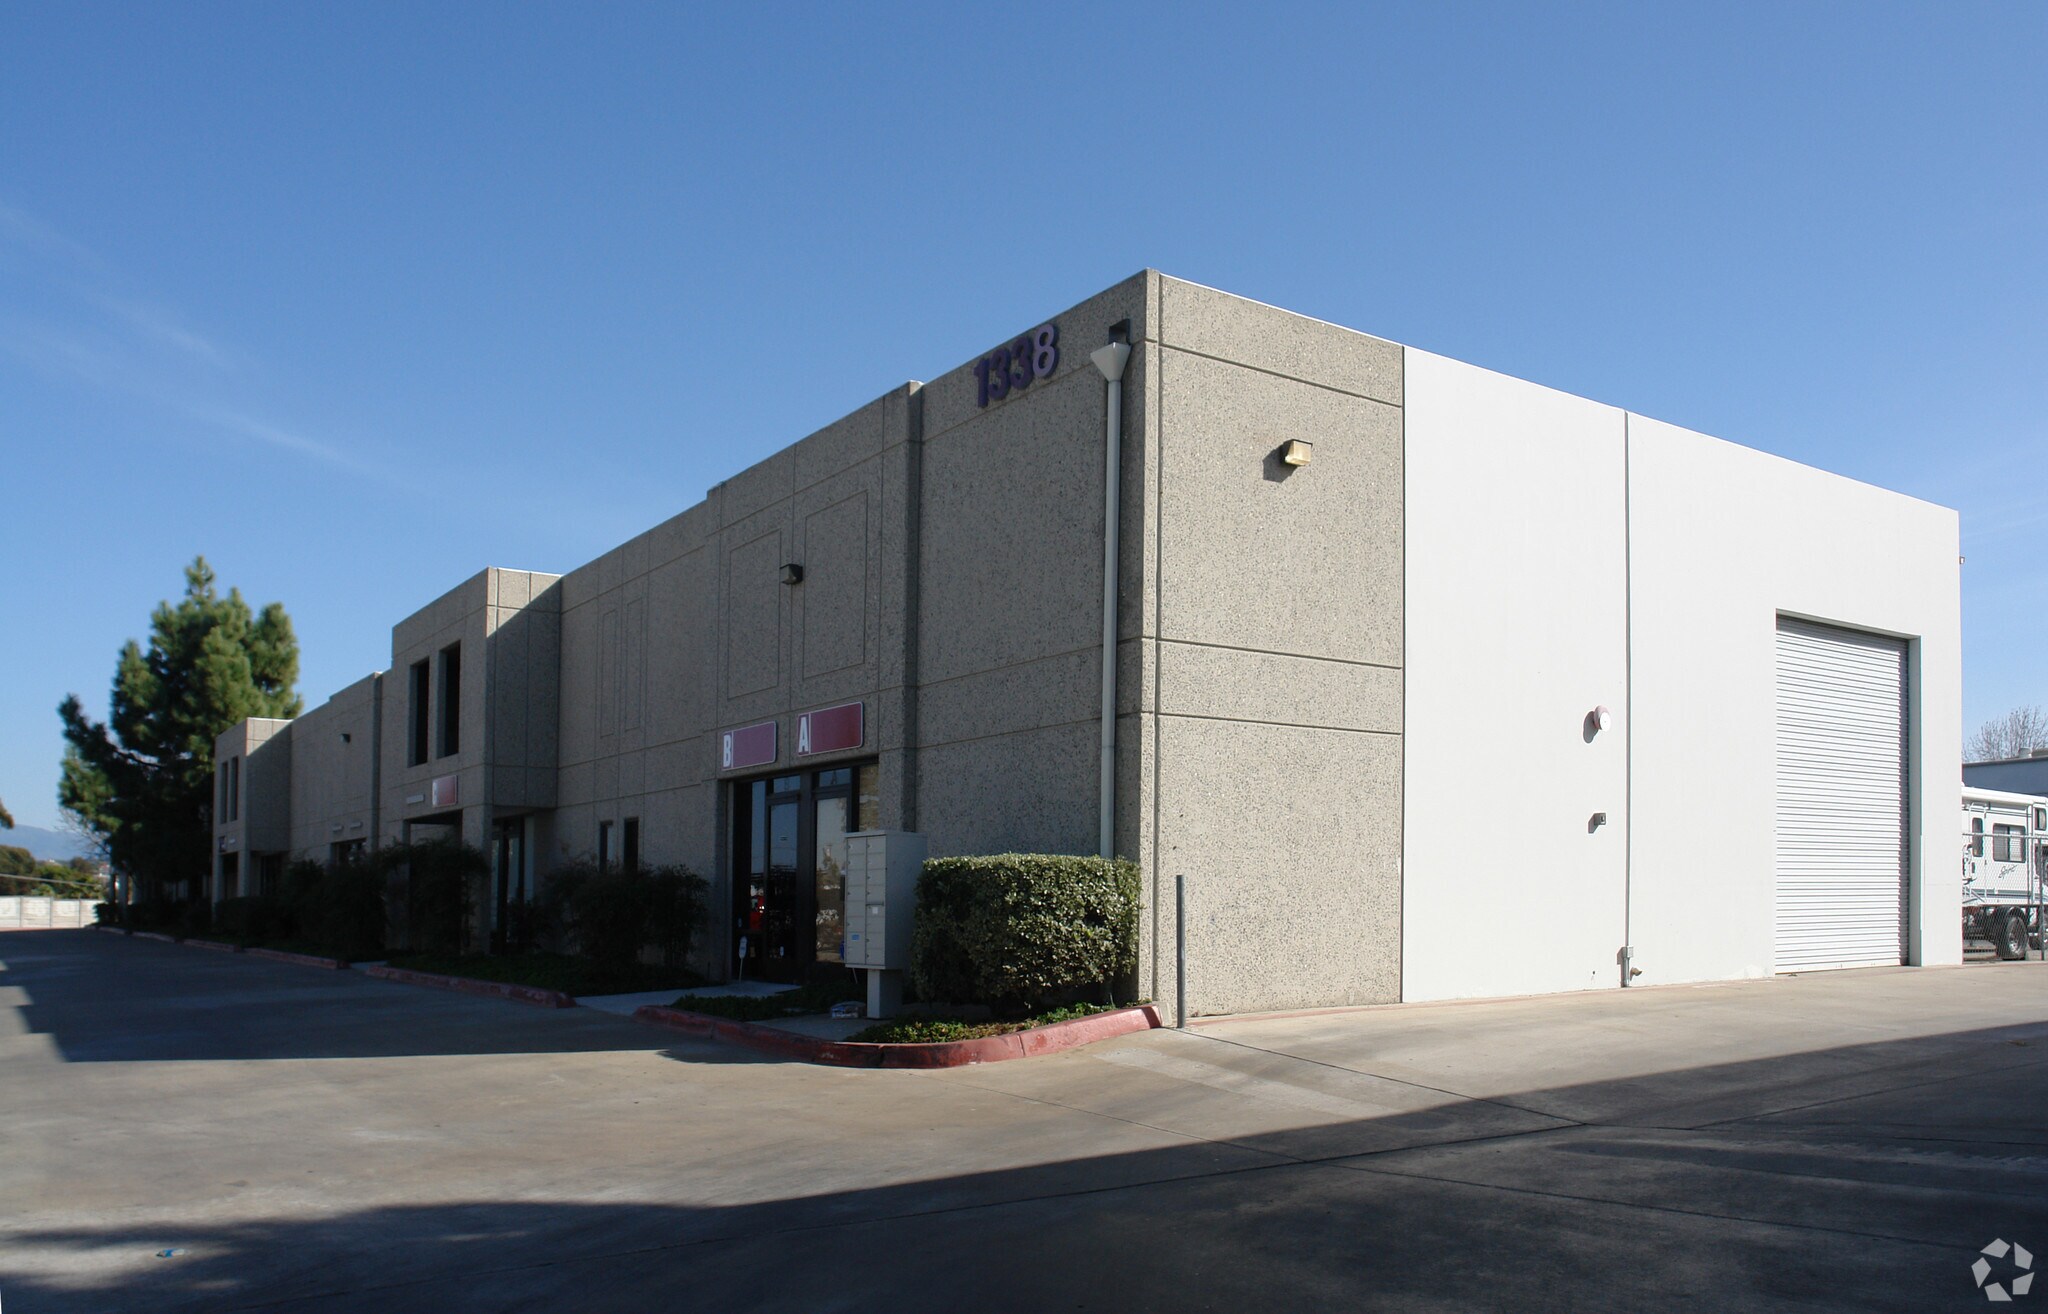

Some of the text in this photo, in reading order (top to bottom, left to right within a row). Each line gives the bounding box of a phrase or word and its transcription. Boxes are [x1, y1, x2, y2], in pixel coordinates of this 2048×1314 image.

[973, 323, 1059, 408] 1338
[723, 734, 732, 768] B
[799, 716, 809, 753] A
